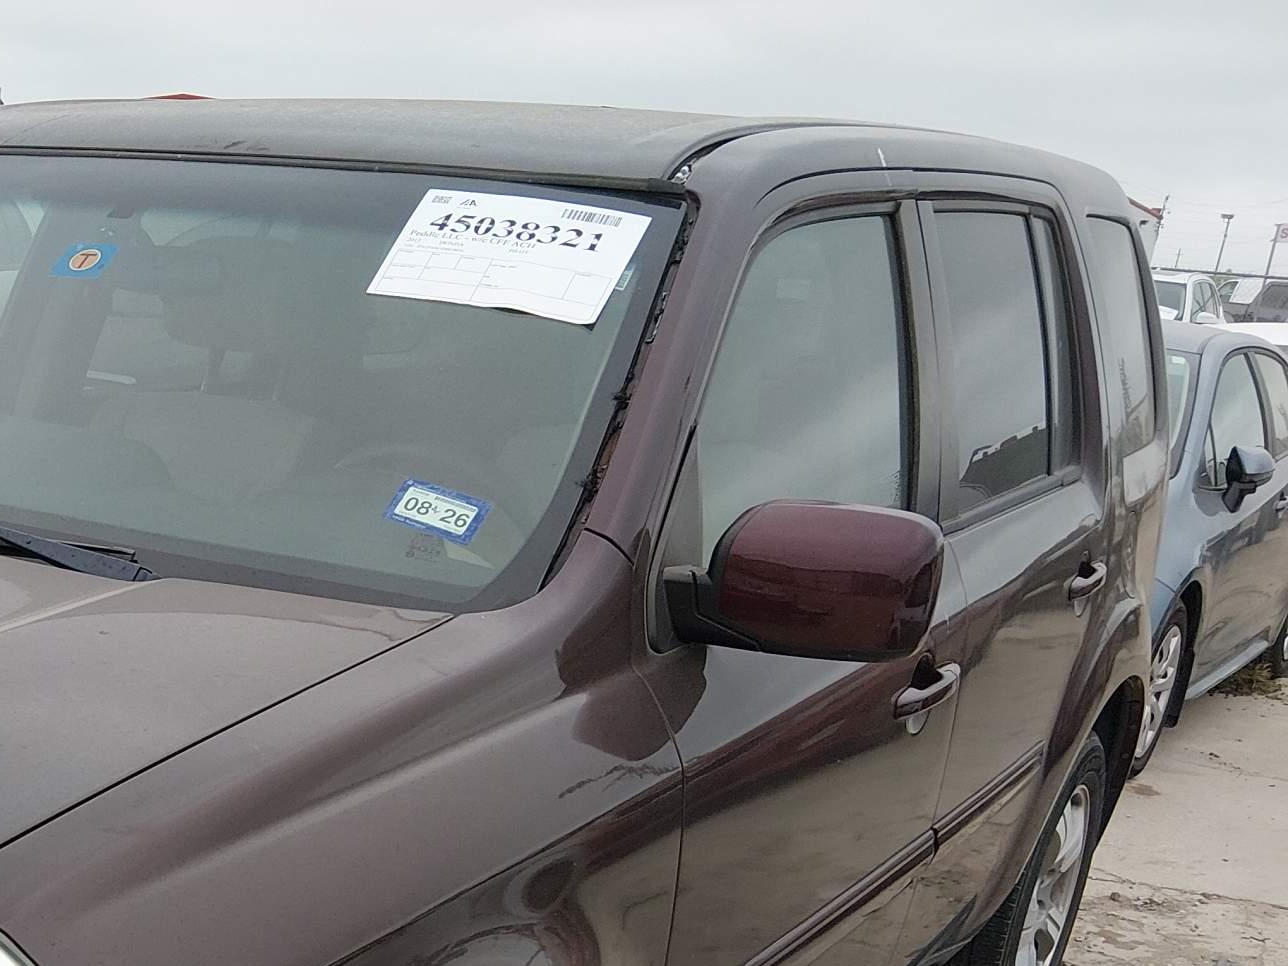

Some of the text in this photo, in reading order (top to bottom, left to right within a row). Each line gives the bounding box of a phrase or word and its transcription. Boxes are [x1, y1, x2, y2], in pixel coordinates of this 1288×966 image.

[429, 212, 603, 252] 45038321
[403, 497, 433, 516] 08
[439, 508, 471, 528] 26
